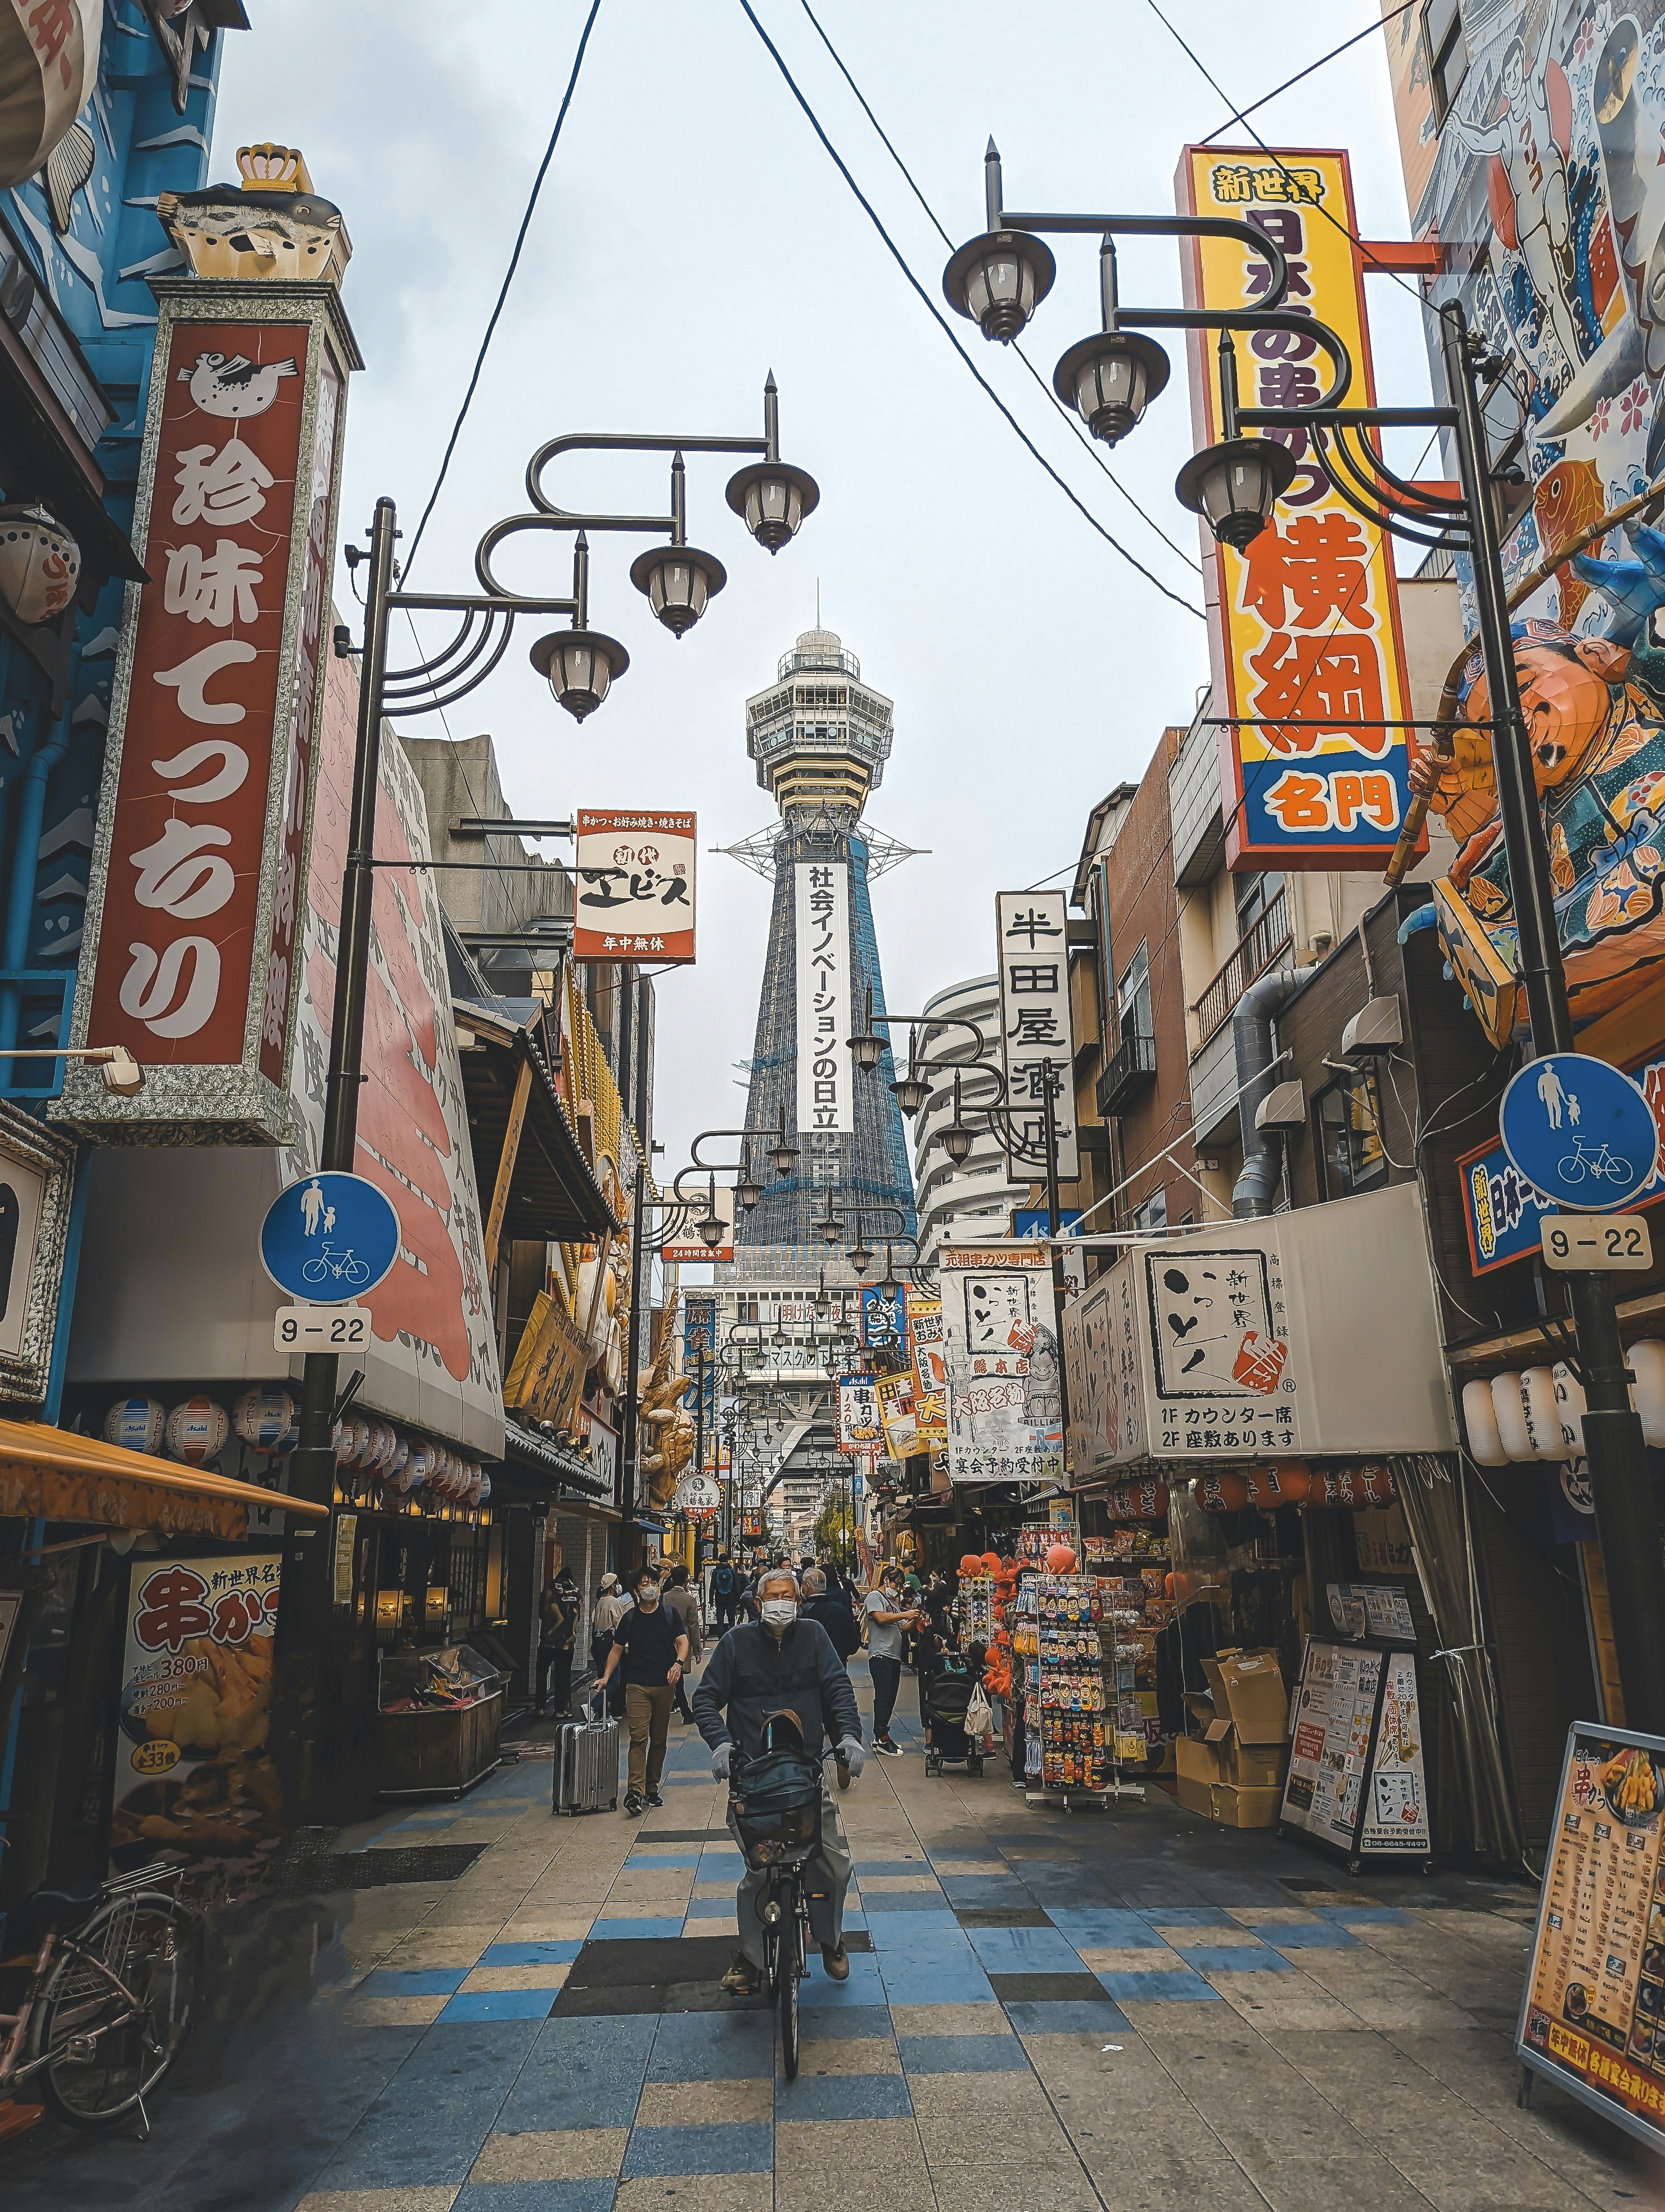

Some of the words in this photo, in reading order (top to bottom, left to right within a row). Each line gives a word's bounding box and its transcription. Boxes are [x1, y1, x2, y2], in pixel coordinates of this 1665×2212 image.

[1213, 165, 1325, 205] 新世界
[1242, 512, 1386, 754] 横綱
[119, 439, 276, 1038] 珍味てっちり
[1269, 774, 1395, 827] 名門
[582, 815, 692, 828] 串かつ・お好み焼き・焼きそば
[579, 868, 690, 908] エビス
[602, 936, 665, 951] 年中無休
[809, 867, 838, 1129] 社会イノベーションの日立
[1006, 908, 1067, 1159] 半田屋酒店
[1473, 1166, 1495, 1257] 新世界
[1489, 1168, 1553, 1235] 日本一
[673, 1249, 723, 1258] 24時間営業中
[946, 1253, 1046, 1266] 元祖串カツ専門店
[1006, 1286, 1022, 1317] 新世界
[1226, 1269, 1256, 1328] 新世界
[1269, 1254, 1289, 1338] 商標登録
[686, 1301, 712, 1350] 麻雀
[1163, 1268, 1230, 1383] いっとく
[849, 1377, 868, 1385] Asahi
[974, 1359, 1030, 1374] 総本店
[853, 1387, 872, 1428] 串カツ
[952, 1382, 1026, 1419] 大阪名物
[1185, 1406, 1292, 1424] カウンター席
[1186, 1429, 1294, 1448] 座敷あります
[954, 1456, 1061, 1475] 宴会予約受付中
[1362, 1467, 1380, 1502] ビール
[160, 1656, 208, 1679] 380円
